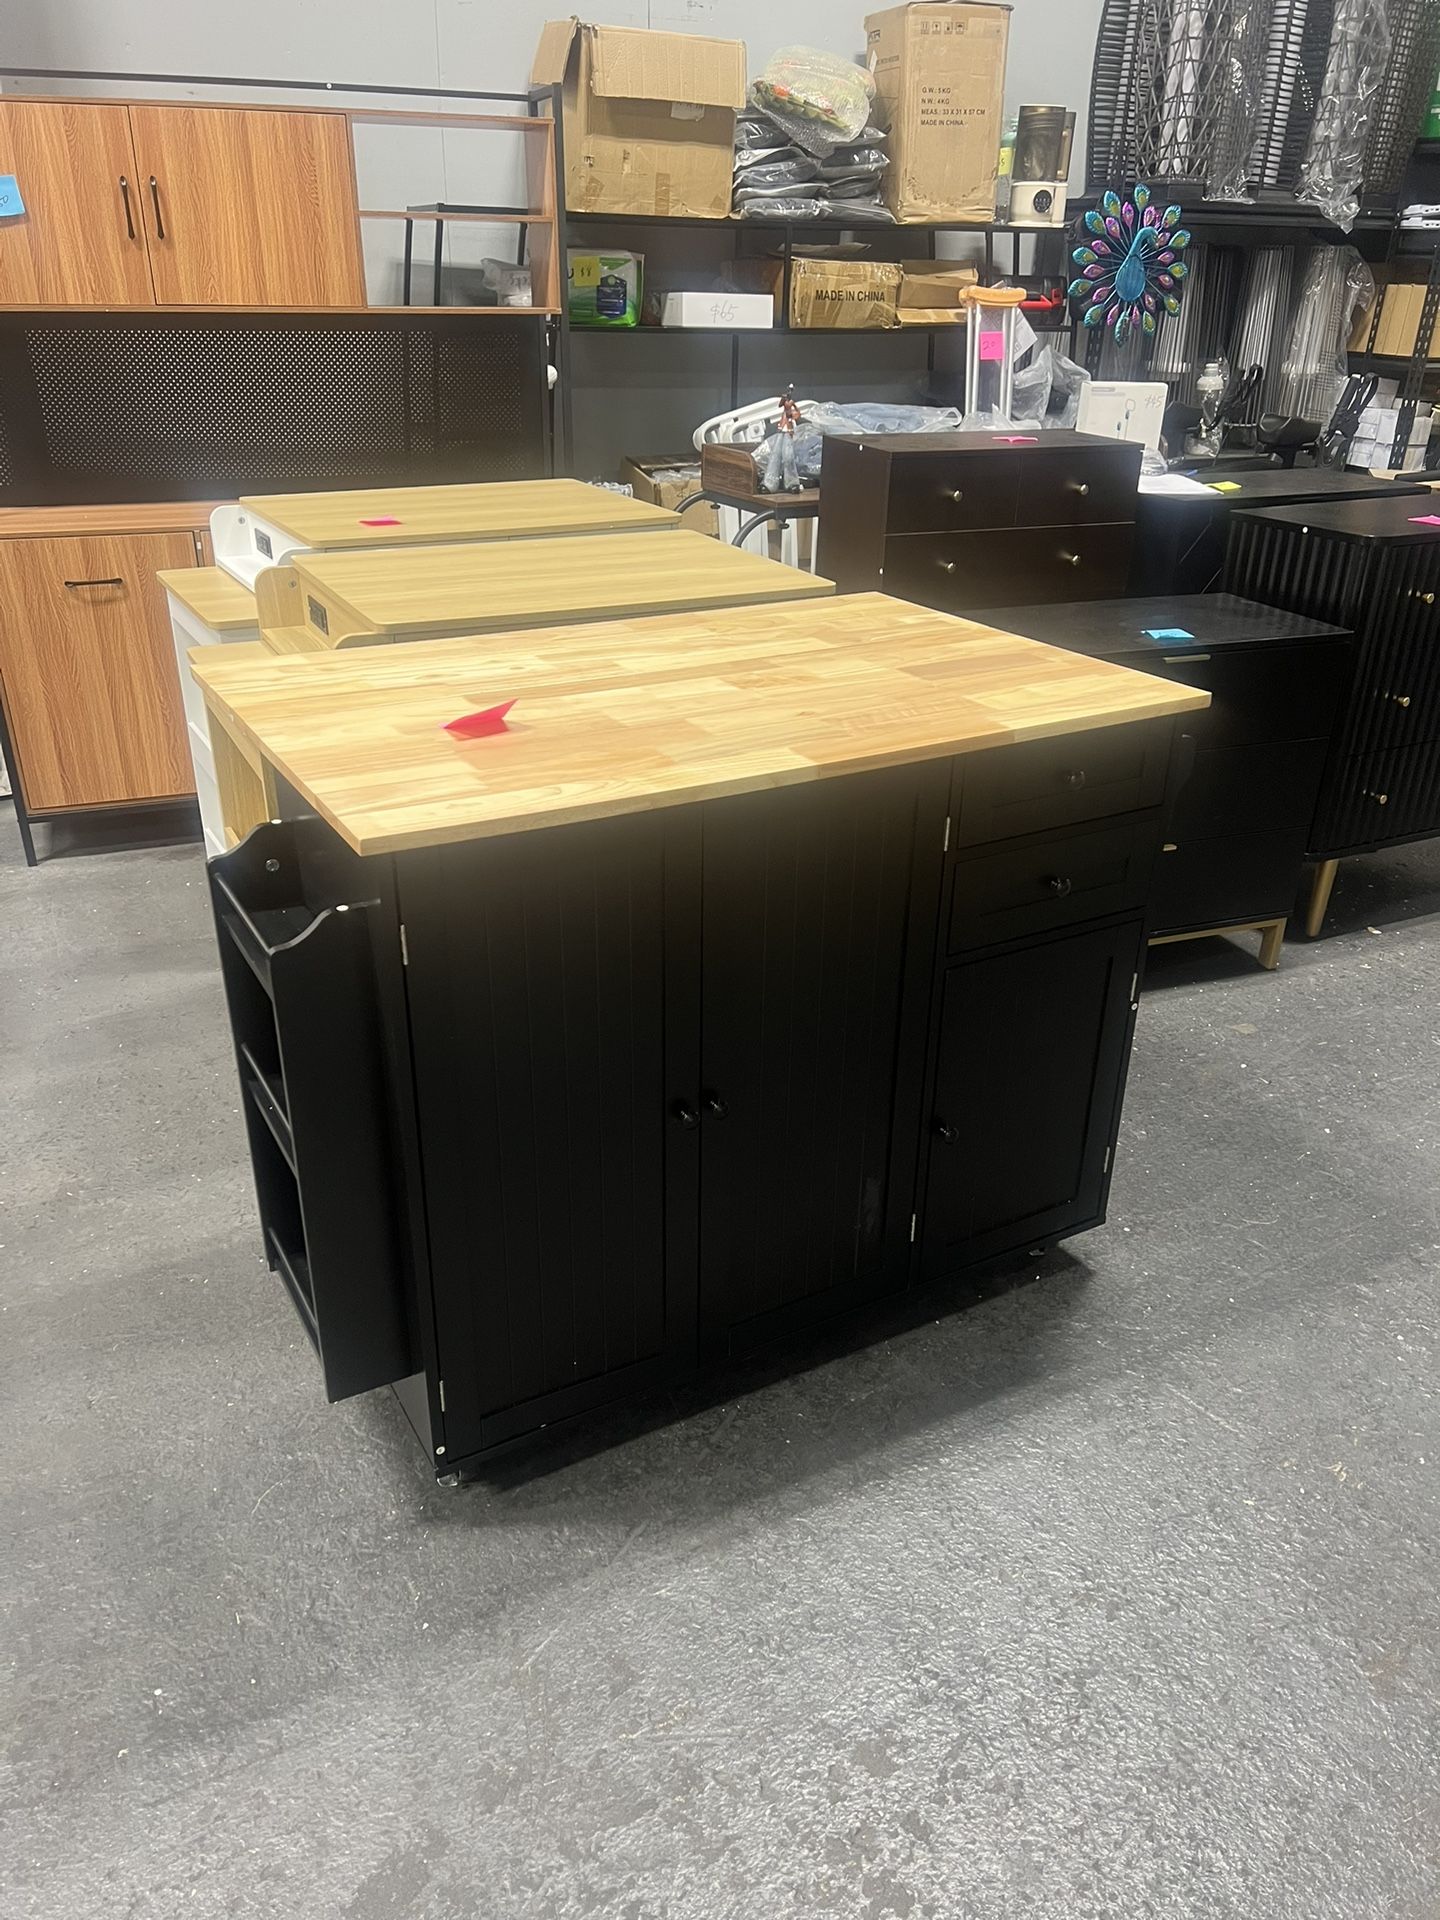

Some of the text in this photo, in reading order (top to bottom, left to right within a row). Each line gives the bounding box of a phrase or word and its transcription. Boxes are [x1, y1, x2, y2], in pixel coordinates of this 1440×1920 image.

[815, 289, 886, 303] MADE IN CHINA
